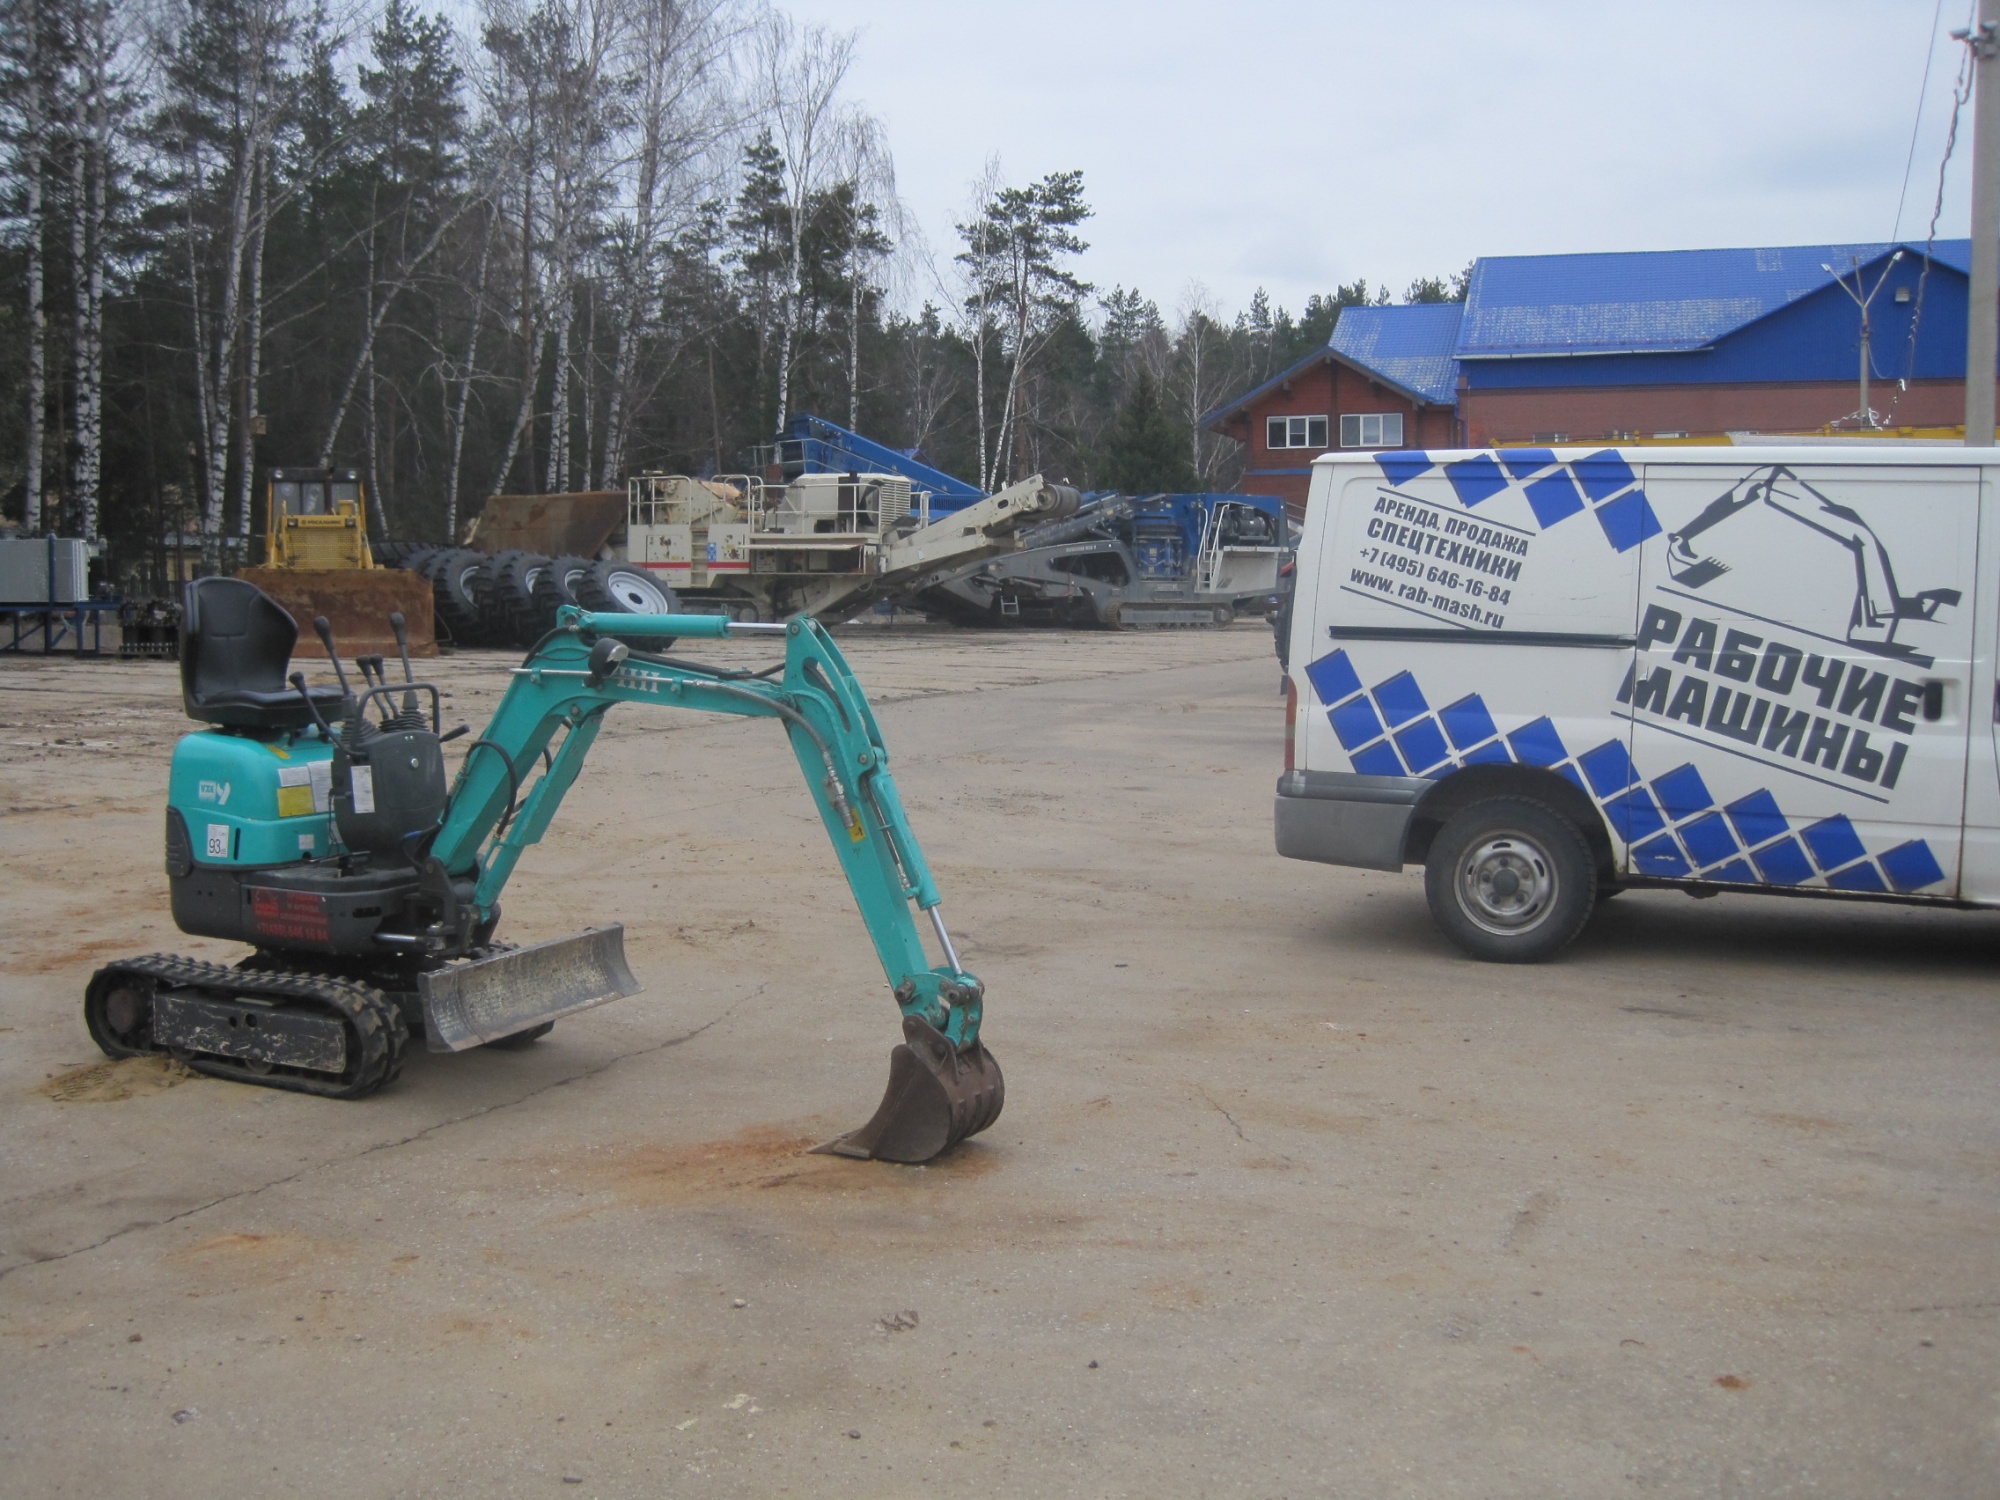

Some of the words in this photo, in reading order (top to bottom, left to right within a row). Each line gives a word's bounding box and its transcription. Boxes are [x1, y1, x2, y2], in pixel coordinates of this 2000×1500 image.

[1367, 517, 1523, 582] СПЕЦТЕХНИКИ
[1373, 496, 1441, 532] АРЕНДА,
[1444, 517, 1529, 557] ПРОДАЖА
[1380, 551, 1425, 578] (495)
[1426, 566, 1511, 606] 646-16-84
[1636, 603, 1925, 736] РАБОЧИЕ
[1615, 659, 1909, 790] МАШИНЫ
[209, 838, 221, 854] 93
